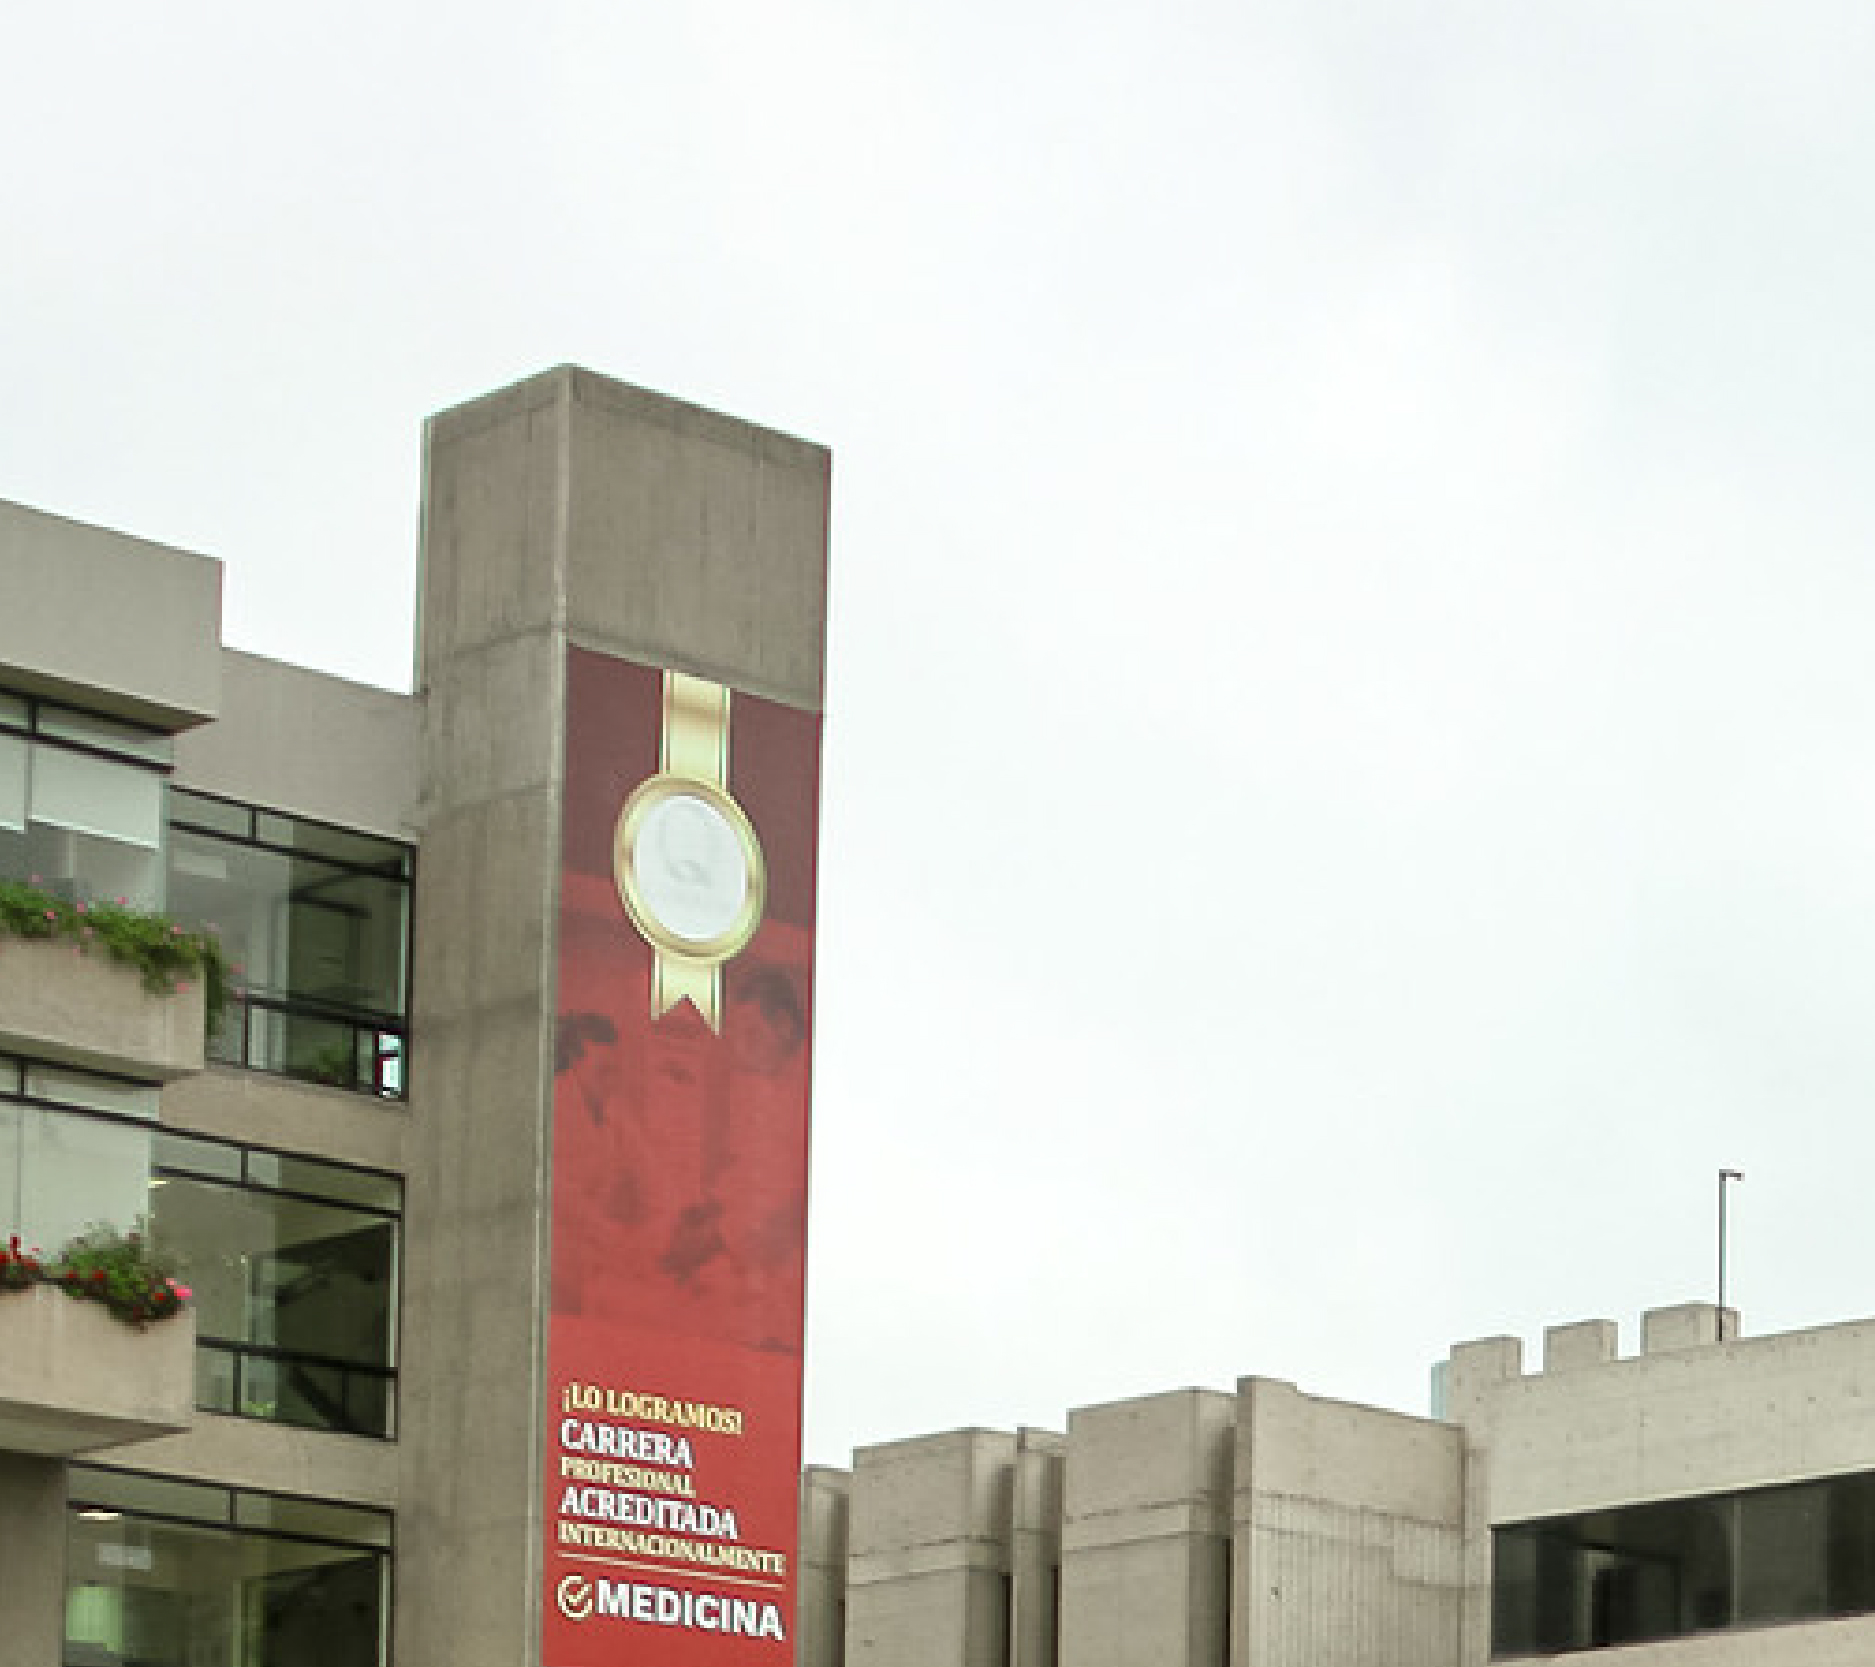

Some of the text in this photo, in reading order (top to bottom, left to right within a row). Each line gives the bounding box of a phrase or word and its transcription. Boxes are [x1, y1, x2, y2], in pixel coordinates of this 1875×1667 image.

[562, 1380, 743, 1435] ¡LO LOGRAMOS!
[559, 1418, 694, 1469] CARRERA
[559, 1456, 697, 1499] PROFESIONAL
[559, 1486, 739, 1540] ACREDITADA
[557, 1519, 788, 1576] INTERNACIONALMENTE
[595, 1577, 787, 1642] MEDICINA
